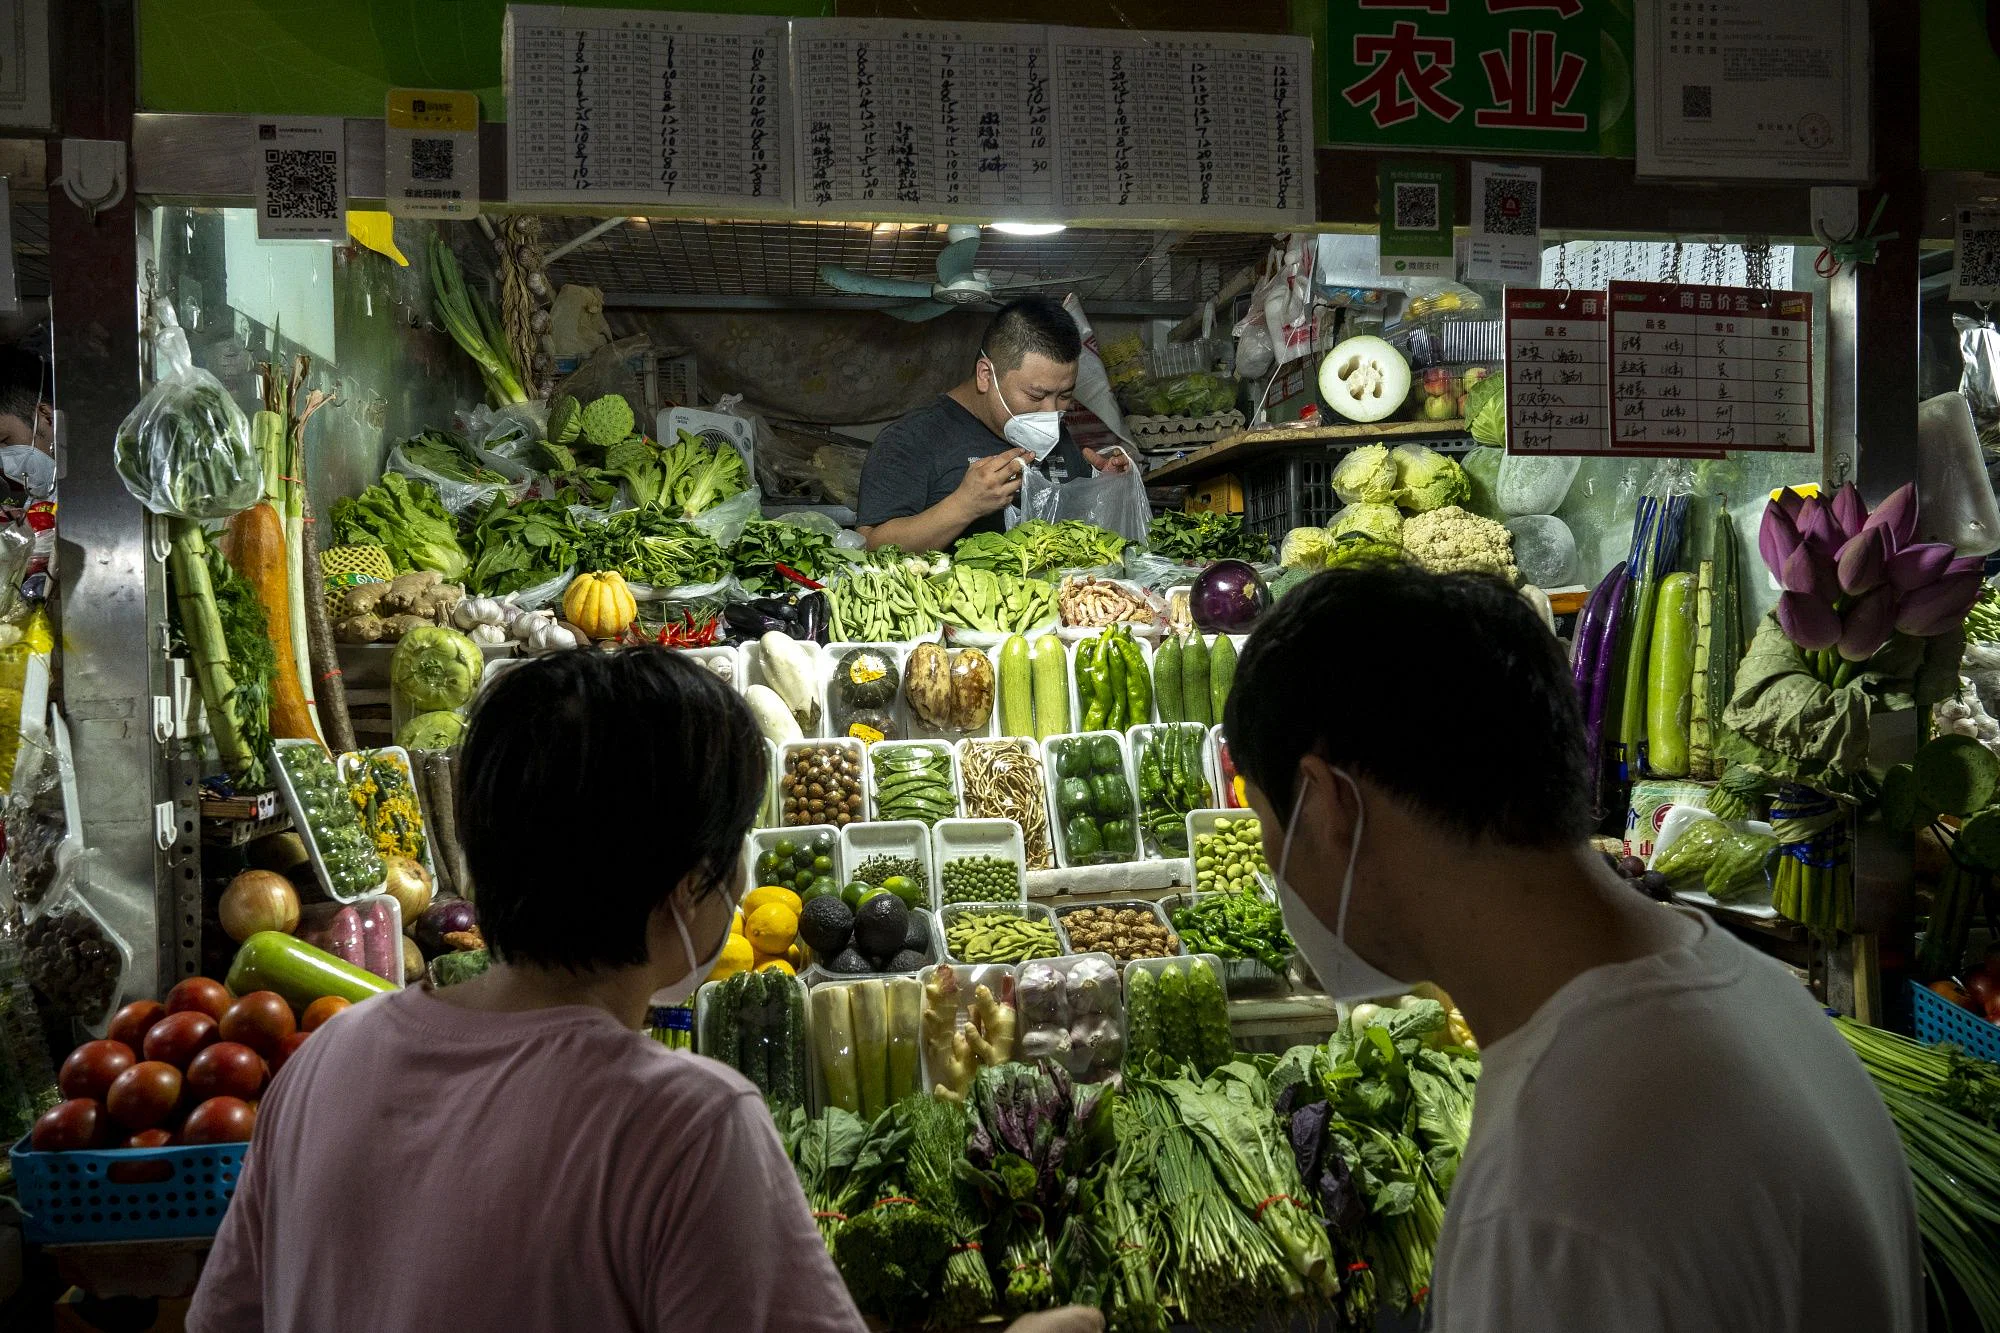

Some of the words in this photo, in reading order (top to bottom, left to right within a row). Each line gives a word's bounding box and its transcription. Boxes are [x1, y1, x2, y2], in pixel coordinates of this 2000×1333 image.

[942, 54, 952, 64] 7
[942, 68, 954, 78] 10
[1192, 63, 1208, 72] 12
[1274, 66, 1288, 76] 12
[1191, 74, 1207, 84] 12
[1274, 77, 1290, 86] 12
[1342, 20, 1589, 132] 农业
[1193, 85, 1206, 94] 12
[1027, 93, 1044, 106] 10
[1194, 94, 1210, 106] 15
[662, 116, 679, 124] 12
[750, 118, 765, 128] 10
[661, 128, 679, 137] 12
[1030, 126, 1043, 136] 10
[1196, 128, 1207, 138] 7
[662, 137, 676, 146] 10
[1031, 137, 1046, 148] 10
[662, 148, 678, 158] 12
[664, 157, 672, 170] 8
[946, 160, 958, 170] 10
[1031, 160, 1048, 174] 30
[661, 170, 678, 180] 10
[946, 171, 958, 182] 10
[1200, 173, 1212, 183] 10
[866, 178, 879, 188] 20
[404, 189, 462, 200] 在此扫码付款
[664, 182, 675, 196] 7
[864, 189, 874, 200] 10
[1408, 261, 1439, 271] 微信支付
[1680, 291, 1751, 312] 商品价签
[1545, 326, 1568, 337] 品名
[1645, 319, 1668, 330] 品名
[1714, 322, 1736, 333] 单位
